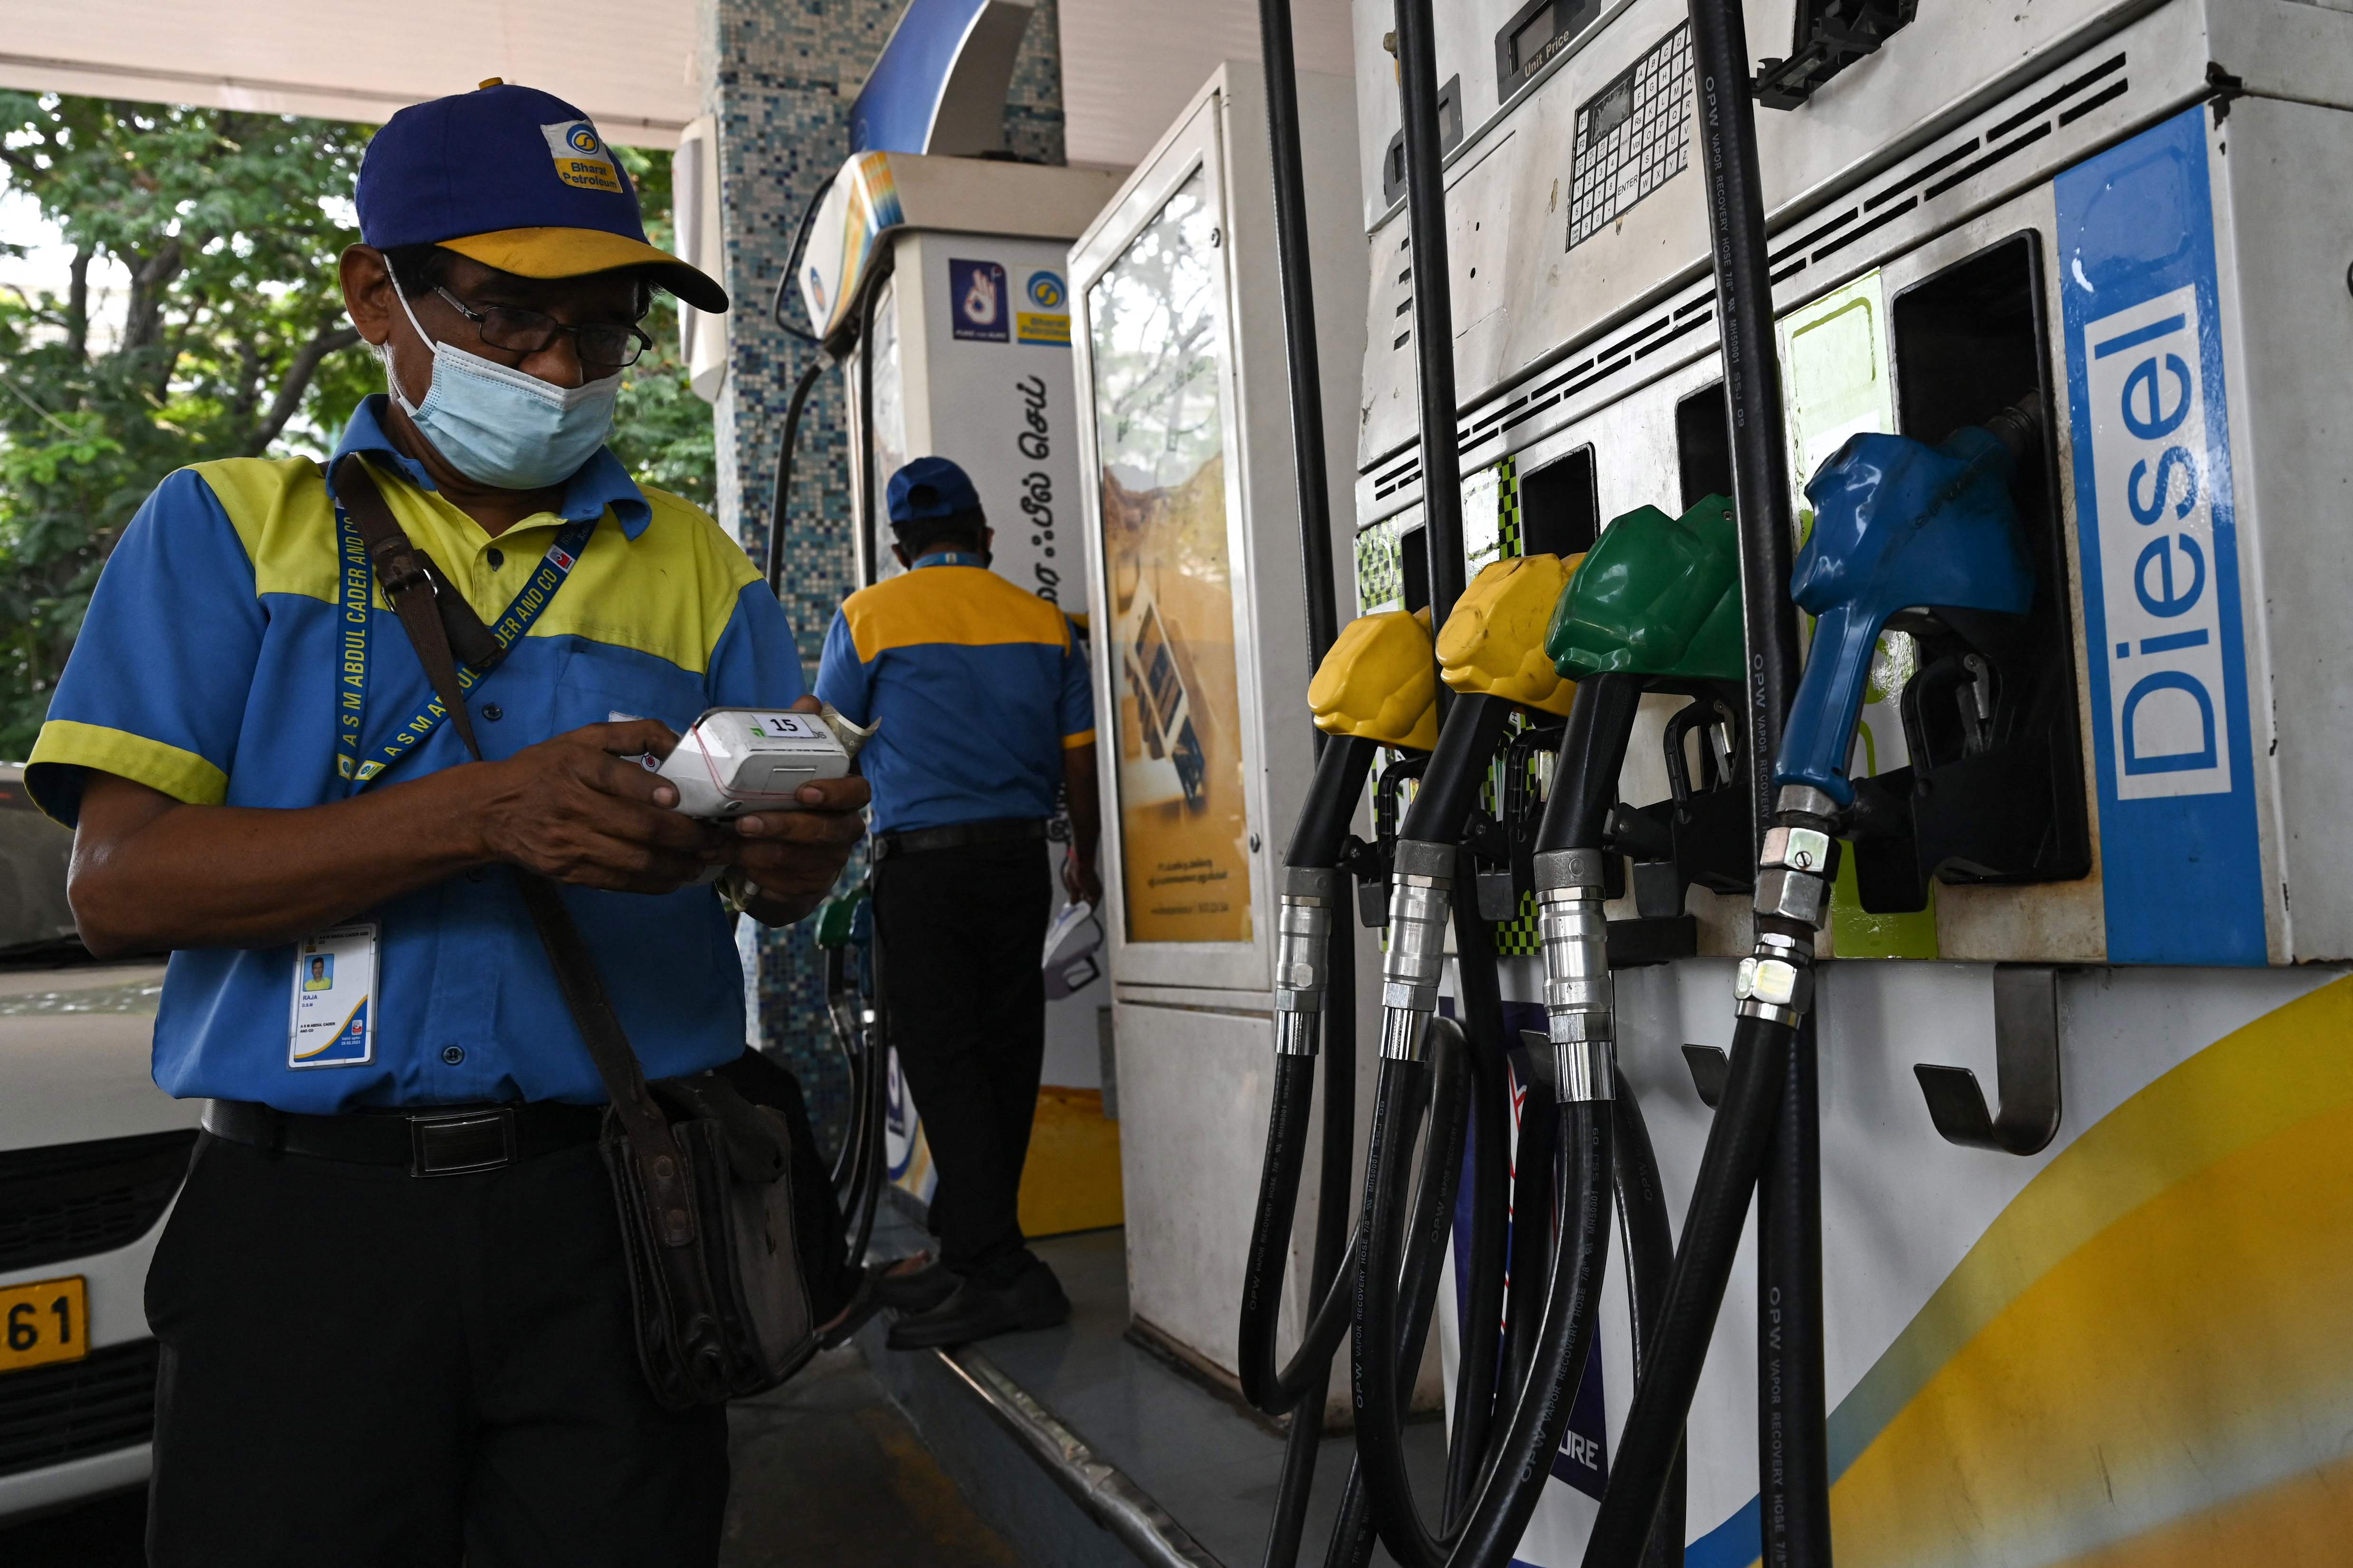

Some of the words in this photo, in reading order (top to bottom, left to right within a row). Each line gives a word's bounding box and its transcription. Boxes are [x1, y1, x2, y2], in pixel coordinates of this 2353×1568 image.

[1677, 37, 1681, 47] D
[1525, 54, 1543, 77] Unit
[1546, 30, 1569, 59] Price
[1664, 48, 1668, 57] C
[1651, 59, 1655, 68] B
[1663, 72, 1667, 82] H
[1688, 75, 1692, 85] N
[1650, 82, 1654, 91] G
[1674, 85, 1679, 96] M
[1638, 92, 1641, 102] F
[1706, 76, 1718, 126] OPW
[1649, 106, 1652, 116] K
[1686, 100, 1690, 110] R
[1581, 117, 1586, 127] F1
[1672, 111, 1677, 119] Q
[1660, 121, 1663, 130] P
[1684, 124, 1689, 134] V
[1579, 139, 1584, 150] F2
[1671, 135, 1675, 144] U
[1658, 144, 1662, 154] T
[1712, 133, 1722, 170] VAPOR
[1645, 155, 1649, 163] S
[1670, 159, 1673, 169] Y
[571, 162, 607, 175] Bharat
[1600, 168, 1603, 176] 3
[1656, 169, 1660, 179] X
[562, 172, 617, 189] Petroleum
[1588, 177, 1591, 185] 2
[1618, 175, 1638, 196] ENTER
[1642, 178, 1649, 189] W
[1598, 190, 1601, 199] 7
[1716, 175, 1728, 232] RECOVERY
[1575, 208, 1578, 216] 5
[1585, 222, 1588, 230] 9
[1722, 237, 1731, 267] HOSE
[1729, 319, 1740, 363] MH50001
[1017, 375, 1049, 460] செய்
[1737, 409, 1744, 426] 09
[345, 536, 366, 566] AND
[2094, 312, 2218, 776] Diesel
[346, 568, 366, 623] CADER
[344, 630, 365, 688] ABDUL
[384, 747, 403, 756] A
[397, 733, 415, 744] S
[408, 715, 433, 733] M
[515, 588, 544, 622] AND
[537, 568, 557, 591] CO
[1754, 653, 1765, 708] OPW
[343, 691, 361, 710] M
[342, 714, 359, 728] S
[770, 718, 798, 732] 15
[342, 735, 357, 747] A
[1758, 715, 1767, 753] VAPOR
[1759, 759, 1770, 820] RECOVERY
[1379, 1101, 1385, 1115] 09
[1368, 1154, 1378, 1192] MH50001
[1431, 1201, 1445, 1242] OPW
[1441, 1170, 1450, 1198] VAPOR
[1250, 1275, 1260, 1311] OPW
[1256, 1247, 1265, 1274] VAPOR
[1261, 1202, 1273, 1243] RECOVERY
[1269, 1177, 1277, 1198] HOSE
[1360, 1238, 1368, 1264] HOSE
[1357, 1269, 1366, 1320] RECOVERY
[1521, 1428, 1547, 1482] OPW
[1544, 1385, 1562, 1422] VAPOR
[1559, 1322, 1578, 1381] RECOVERY
[1574, 1287, 1586, 1318] HOSE
[1588, 1191, 1598, 1234] MH50001
[1593, 1128, 1599, 1144] 09
[1769, 1286, 1781, 1350] OPW
[1356, 1362, 1364, 1408] OPW
[1770, 1360, 1781, 1404] VAPOR
[1558, 1429, 1599, 1471] URE
[1772, 1412, 1784, 1486] RECOVERY
[1774, 1493, 1785, 1534] HOSE
